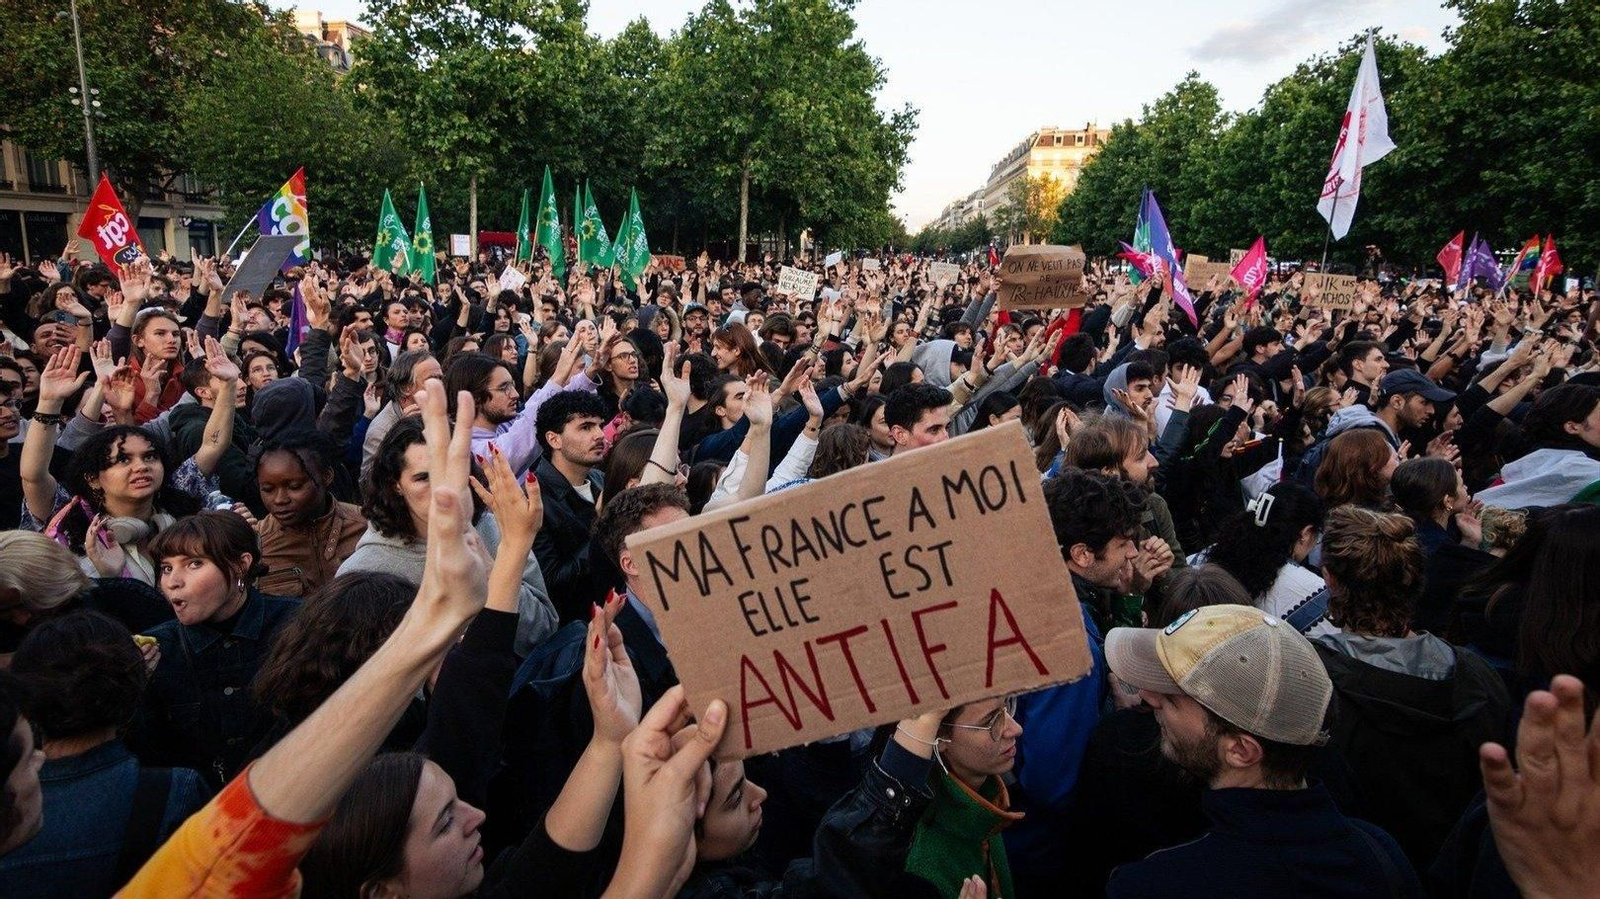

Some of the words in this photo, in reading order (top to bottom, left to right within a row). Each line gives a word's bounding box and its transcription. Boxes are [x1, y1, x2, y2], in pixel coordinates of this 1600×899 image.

[1008, 261, 1023, 274] ON
[1026, 260, 1039, 272] NE
[1040, 259, 1063, 271] VEUT
[1066, 258, 1081, 270] PAS
[1320, 293, 1351, 305] ACHOS
[645, 530, 734, 611] MA
[727, 495, 892, 580] FRANCE
[908, 486, 937, 533] A
[941, 460, 1027, 521] MOI
[737, 578, 820, 637] ELLE
[879, 540, 954, 600] EST
[738, 588, 1050, 750] ANTIFA
